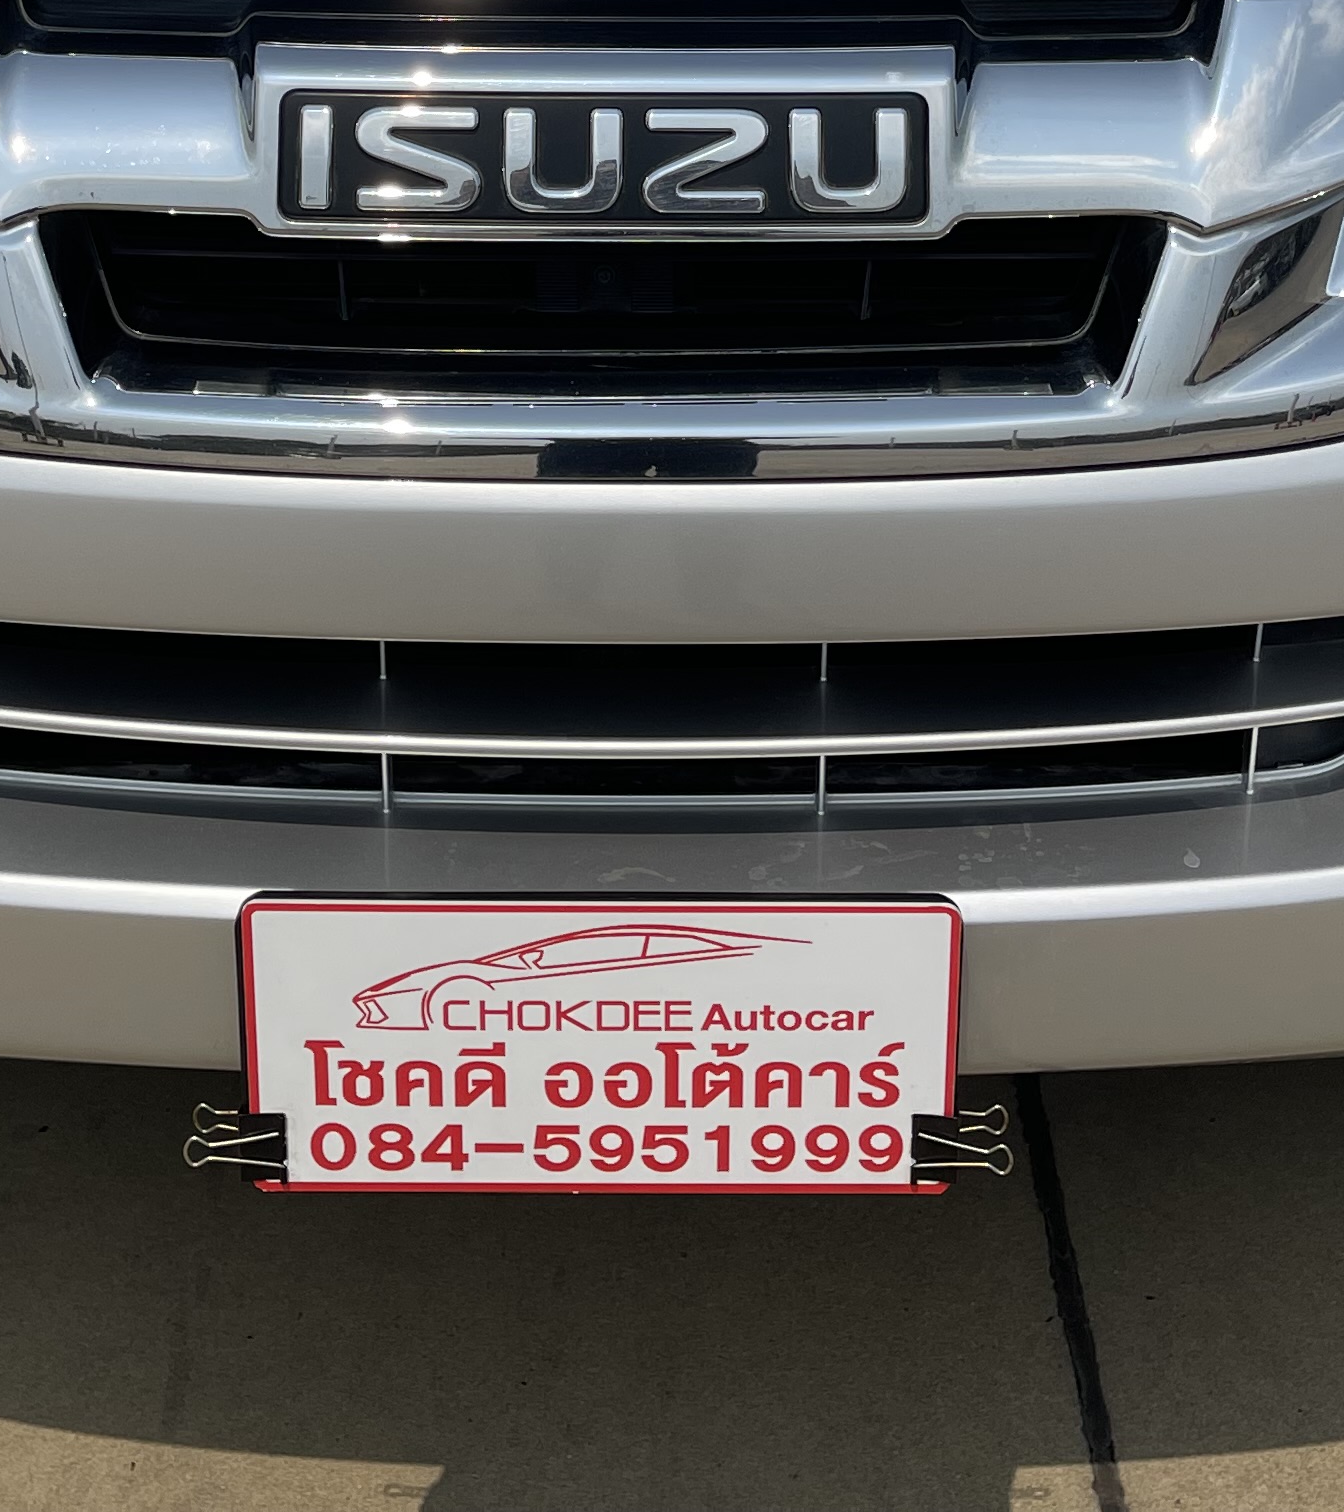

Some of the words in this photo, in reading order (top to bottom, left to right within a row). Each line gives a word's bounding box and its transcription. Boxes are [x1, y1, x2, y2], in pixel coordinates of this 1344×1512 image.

[298, 104, 908, 213] ISUZU
[442, 999, 693, 1032] CHOKDEE
[701, 1003, 875, 1032] Autocar
[304, 1040, 507, 1108] โชคดี
[543, 1041, 906, 1109] ออโต้คาร์
[309, 1121, 904, 1174] 084-5951999
